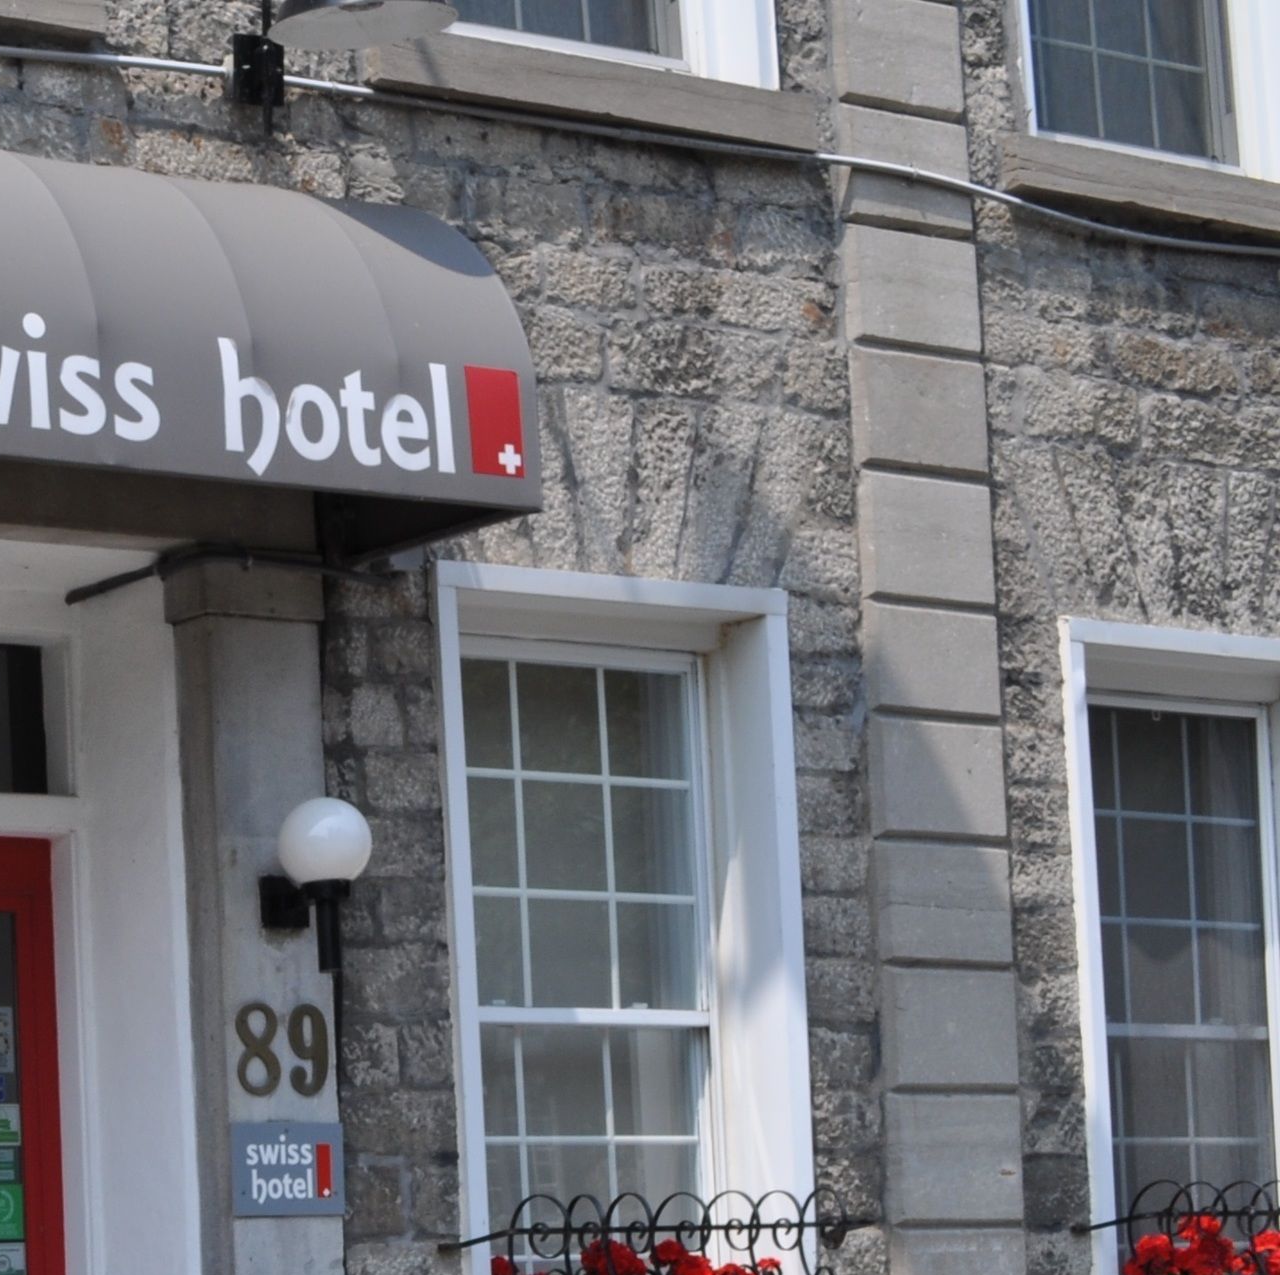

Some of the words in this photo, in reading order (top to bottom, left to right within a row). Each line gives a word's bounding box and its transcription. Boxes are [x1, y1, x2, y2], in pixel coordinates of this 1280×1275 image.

[217, 336, 455, 476] hotel
[235, 1002, 329, 1097] 89
[246, 1134, 313, 1165] swiss
[251, 1168, 314, 1205] hotel
